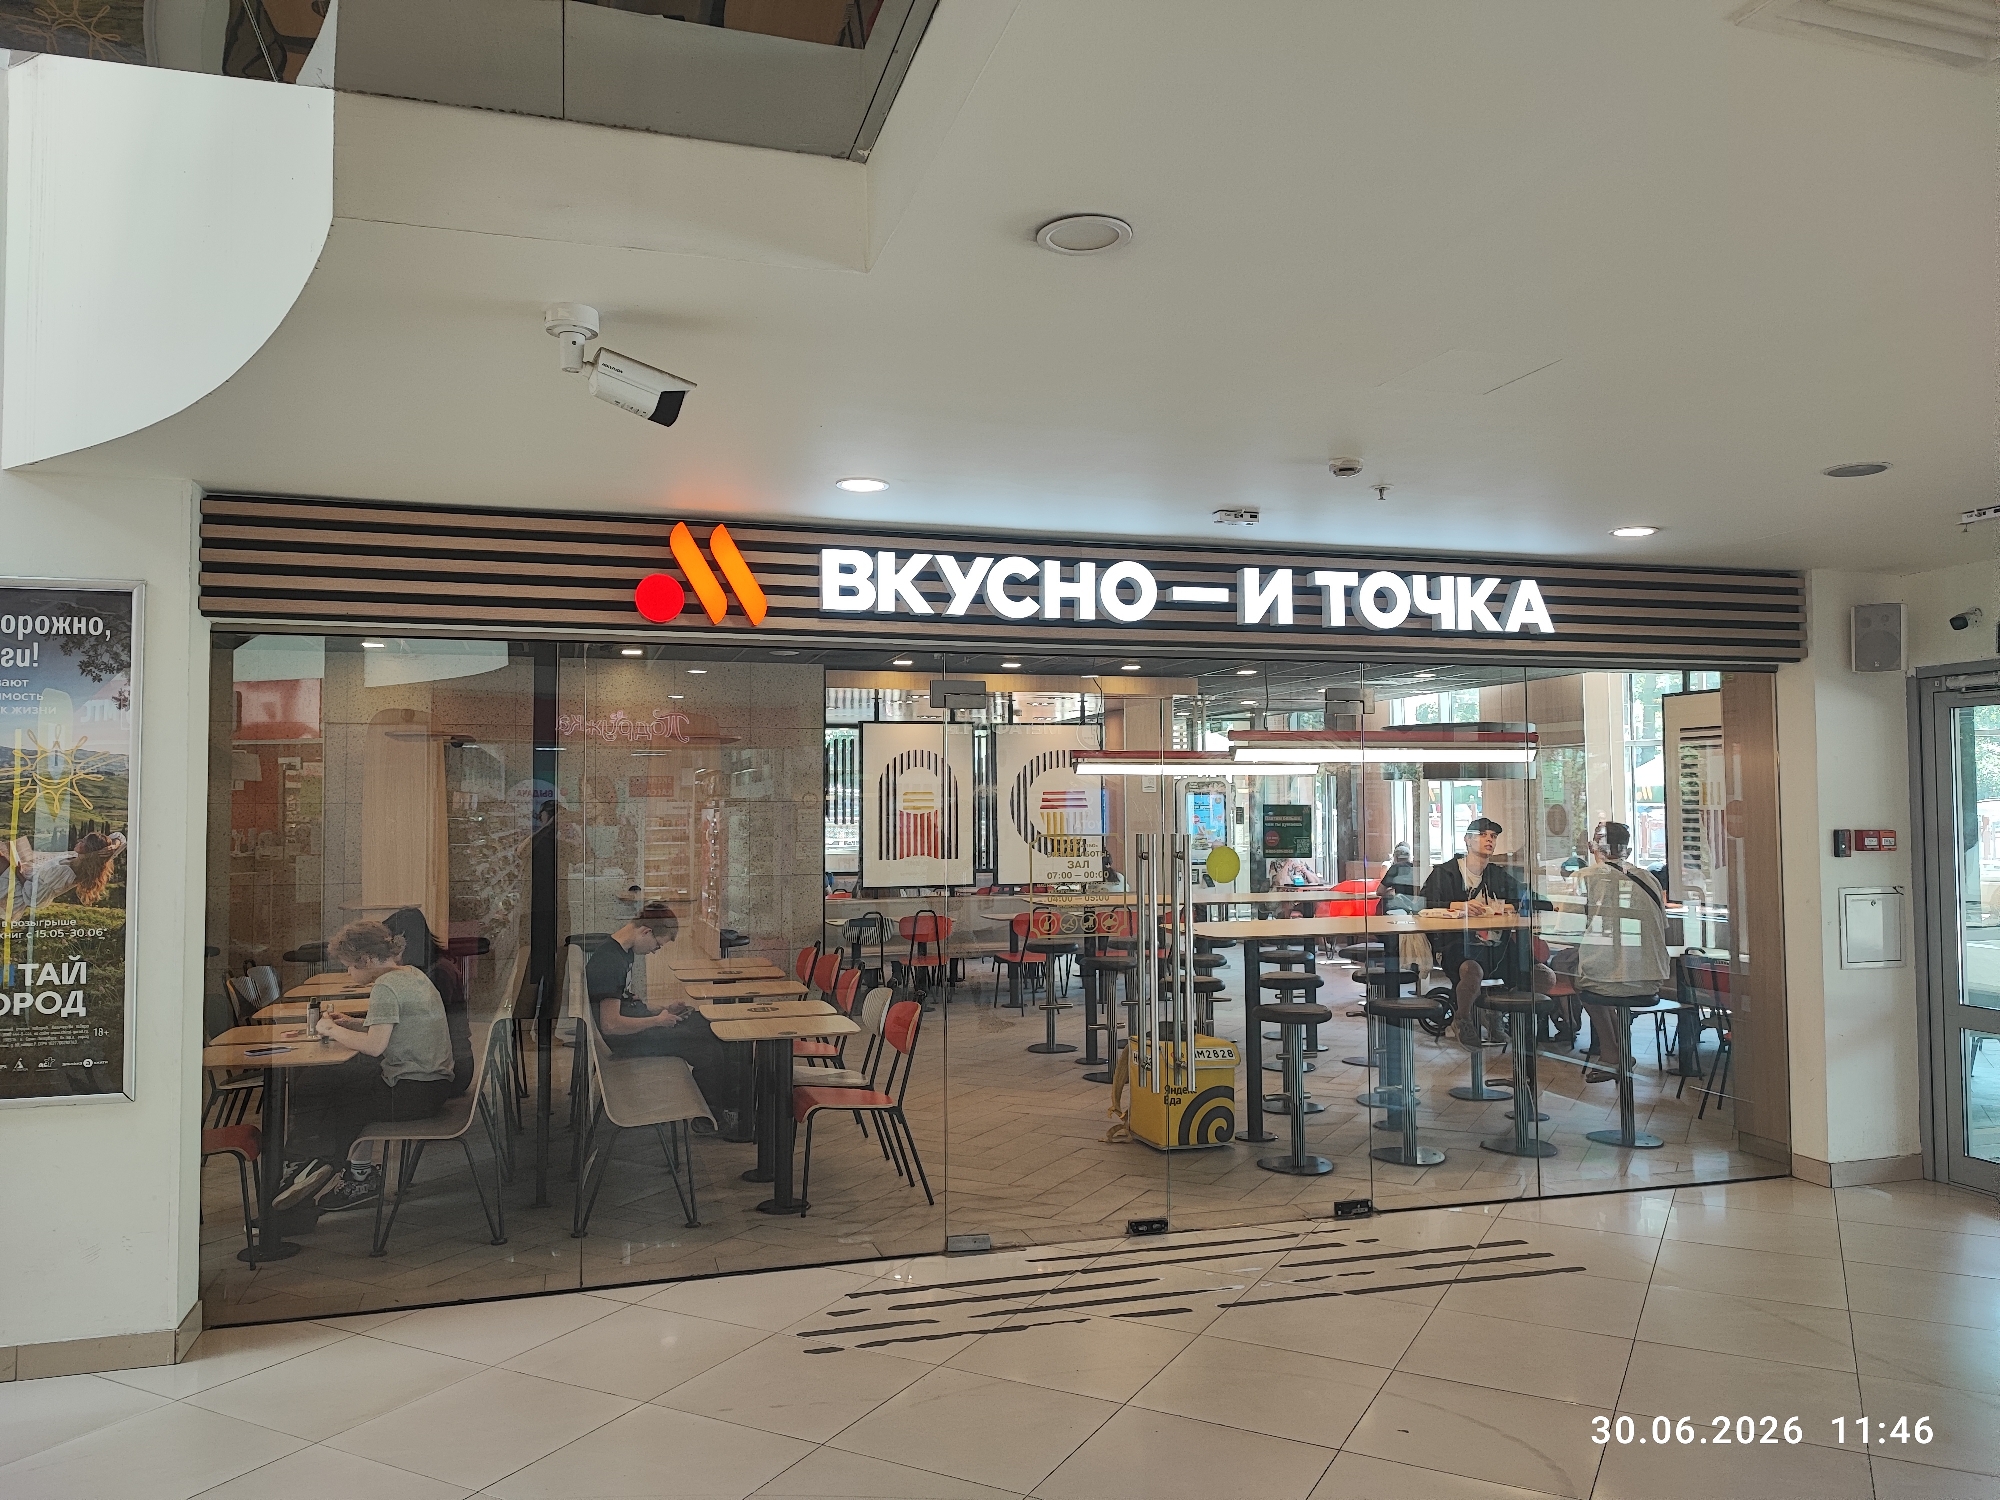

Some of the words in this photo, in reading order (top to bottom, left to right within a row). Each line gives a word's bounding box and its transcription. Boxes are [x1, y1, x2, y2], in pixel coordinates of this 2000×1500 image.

[819, 548, 1157, 623] ВКУСНО
[1237, 568, 1293, 626] И
[1309, 569, 1556, 634] ТОЧКА
[0, 613, 112, 641] орожно,
[0, 706, 8, 715] к
[11, 706, 57, 715] жизни
[1067, 860, 1090, 869] ЗАЛ
[1047, 871, 1072, 879] 07:00
[11, 918, 77, 929] розыгрыше
[93, 1027, 110, 1037] 18+
[1163, 1095, 1182, 1106] Еда
